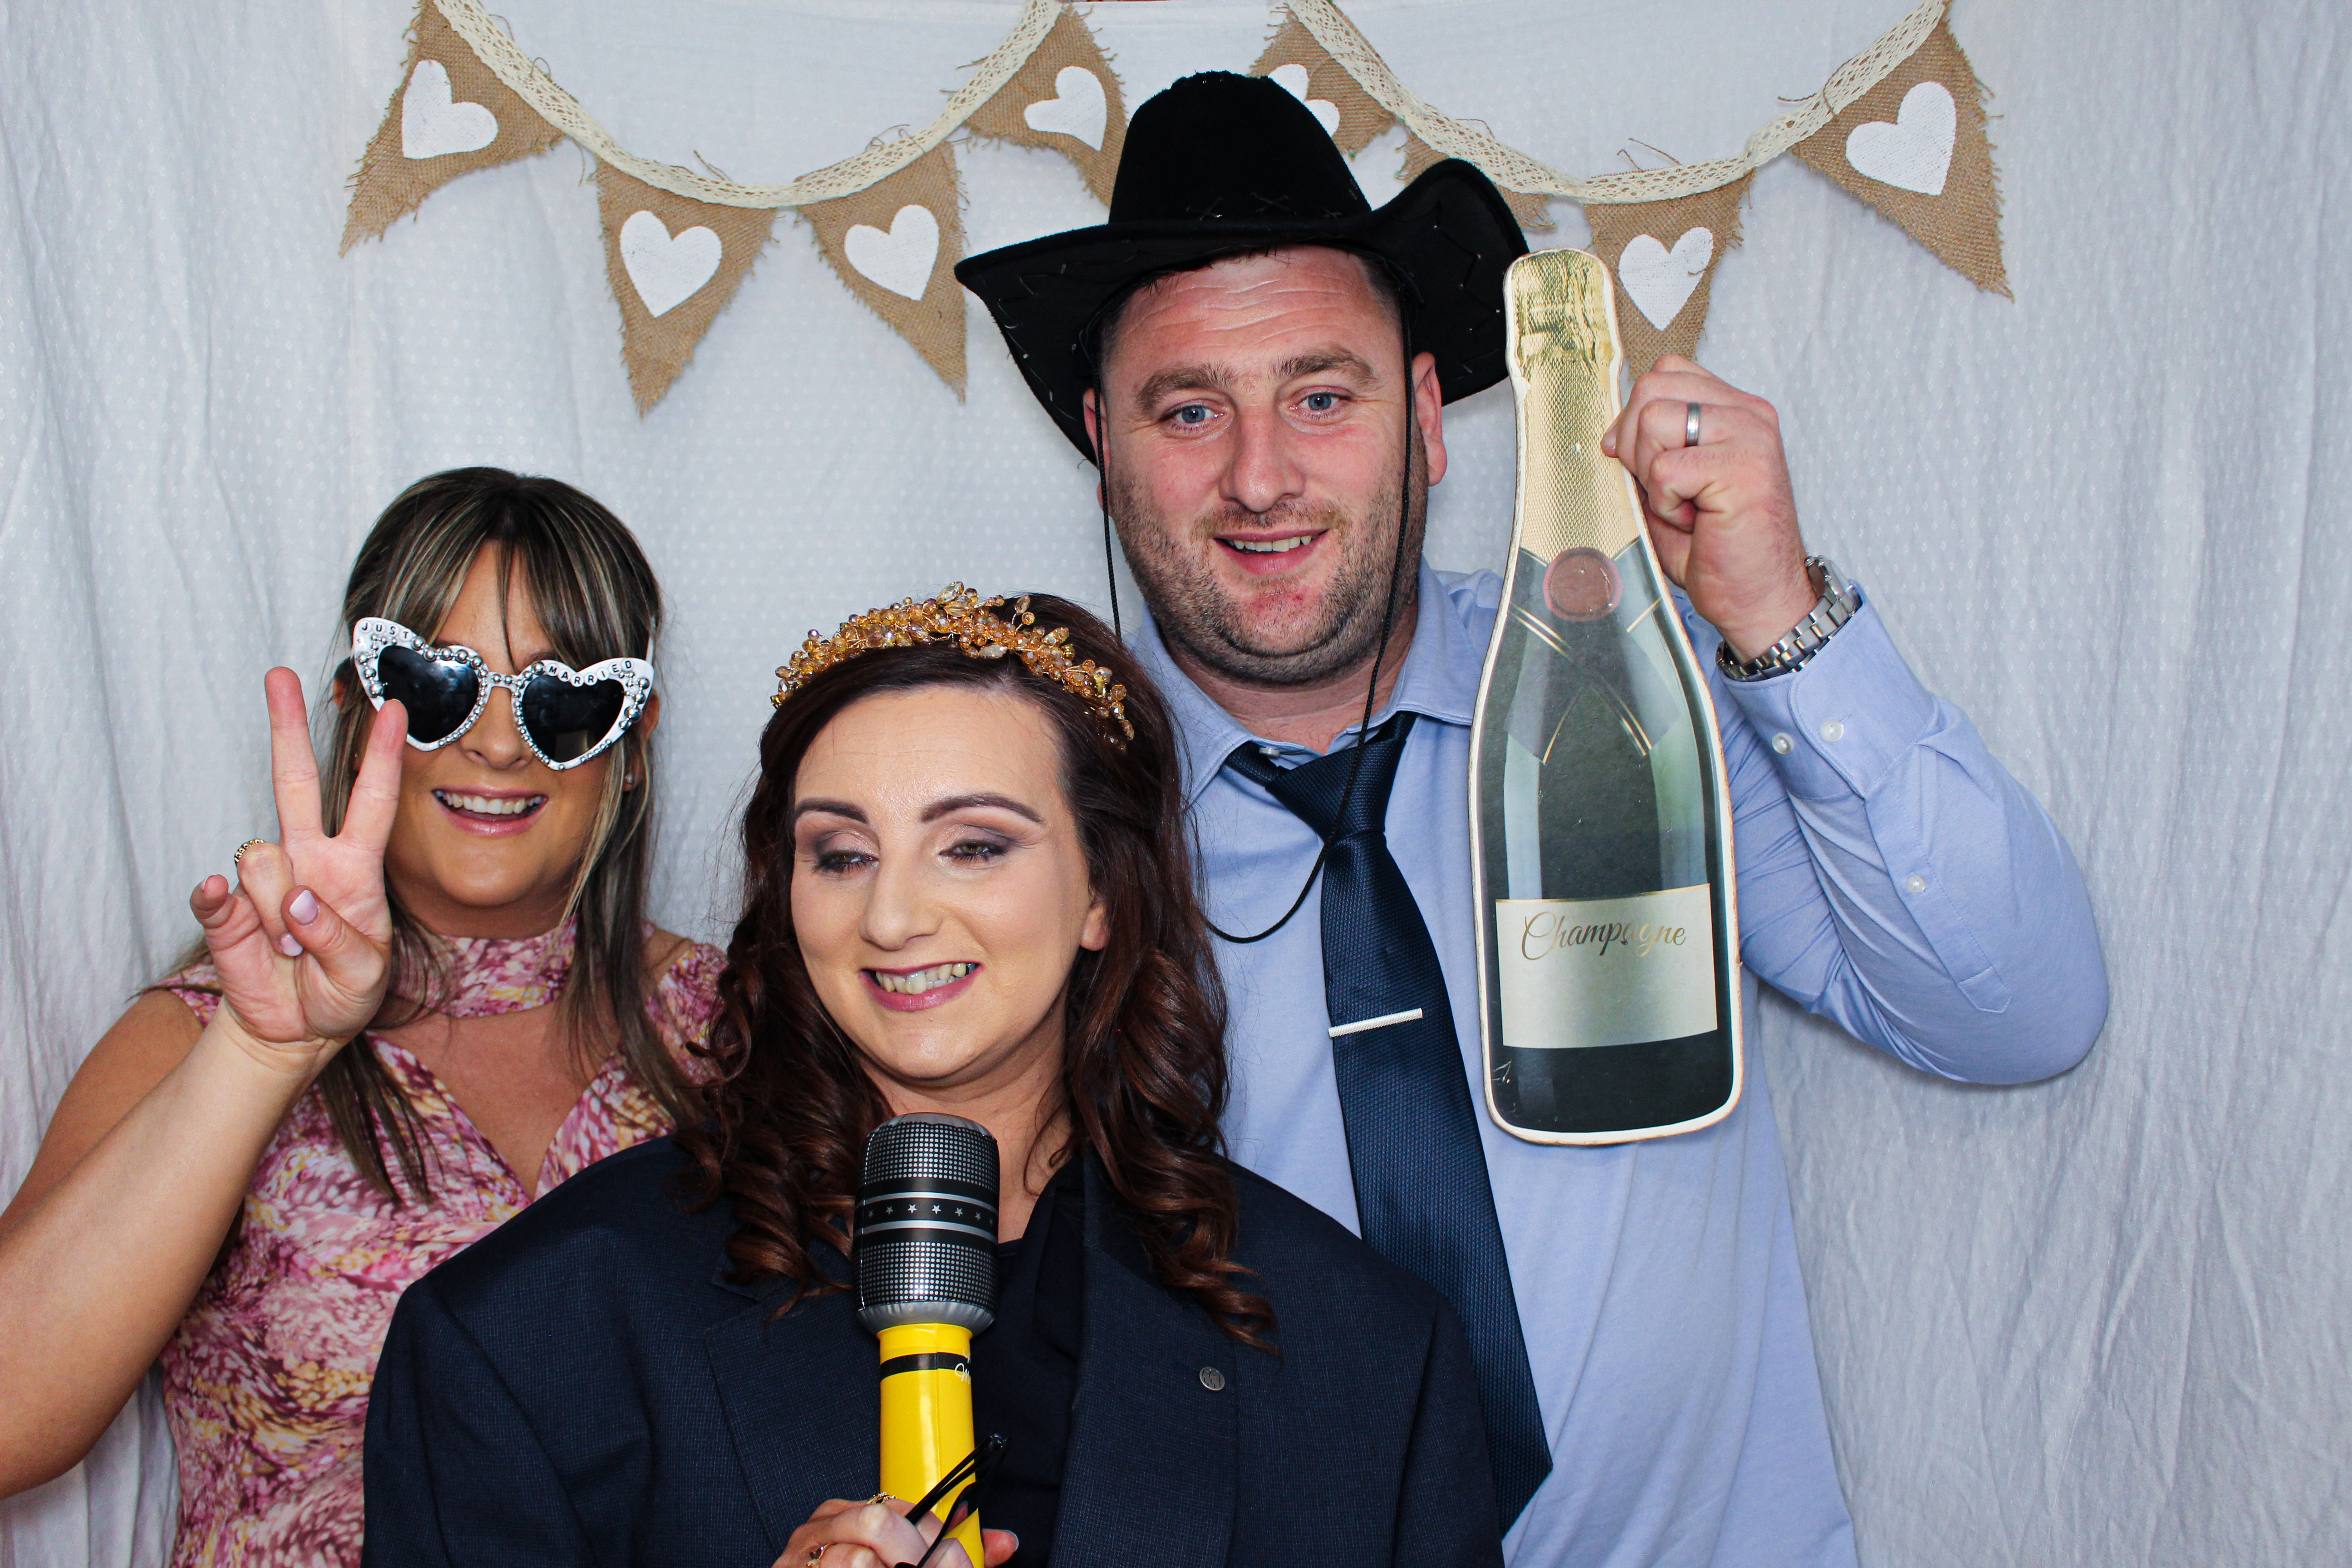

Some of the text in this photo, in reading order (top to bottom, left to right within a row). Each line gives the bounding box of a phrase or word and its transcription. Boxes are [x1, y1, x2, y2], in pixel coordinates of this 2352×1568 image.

[362, 622, 632, 684] JUST MARRIED
[1522, 911, 1686, 960] Champagne
